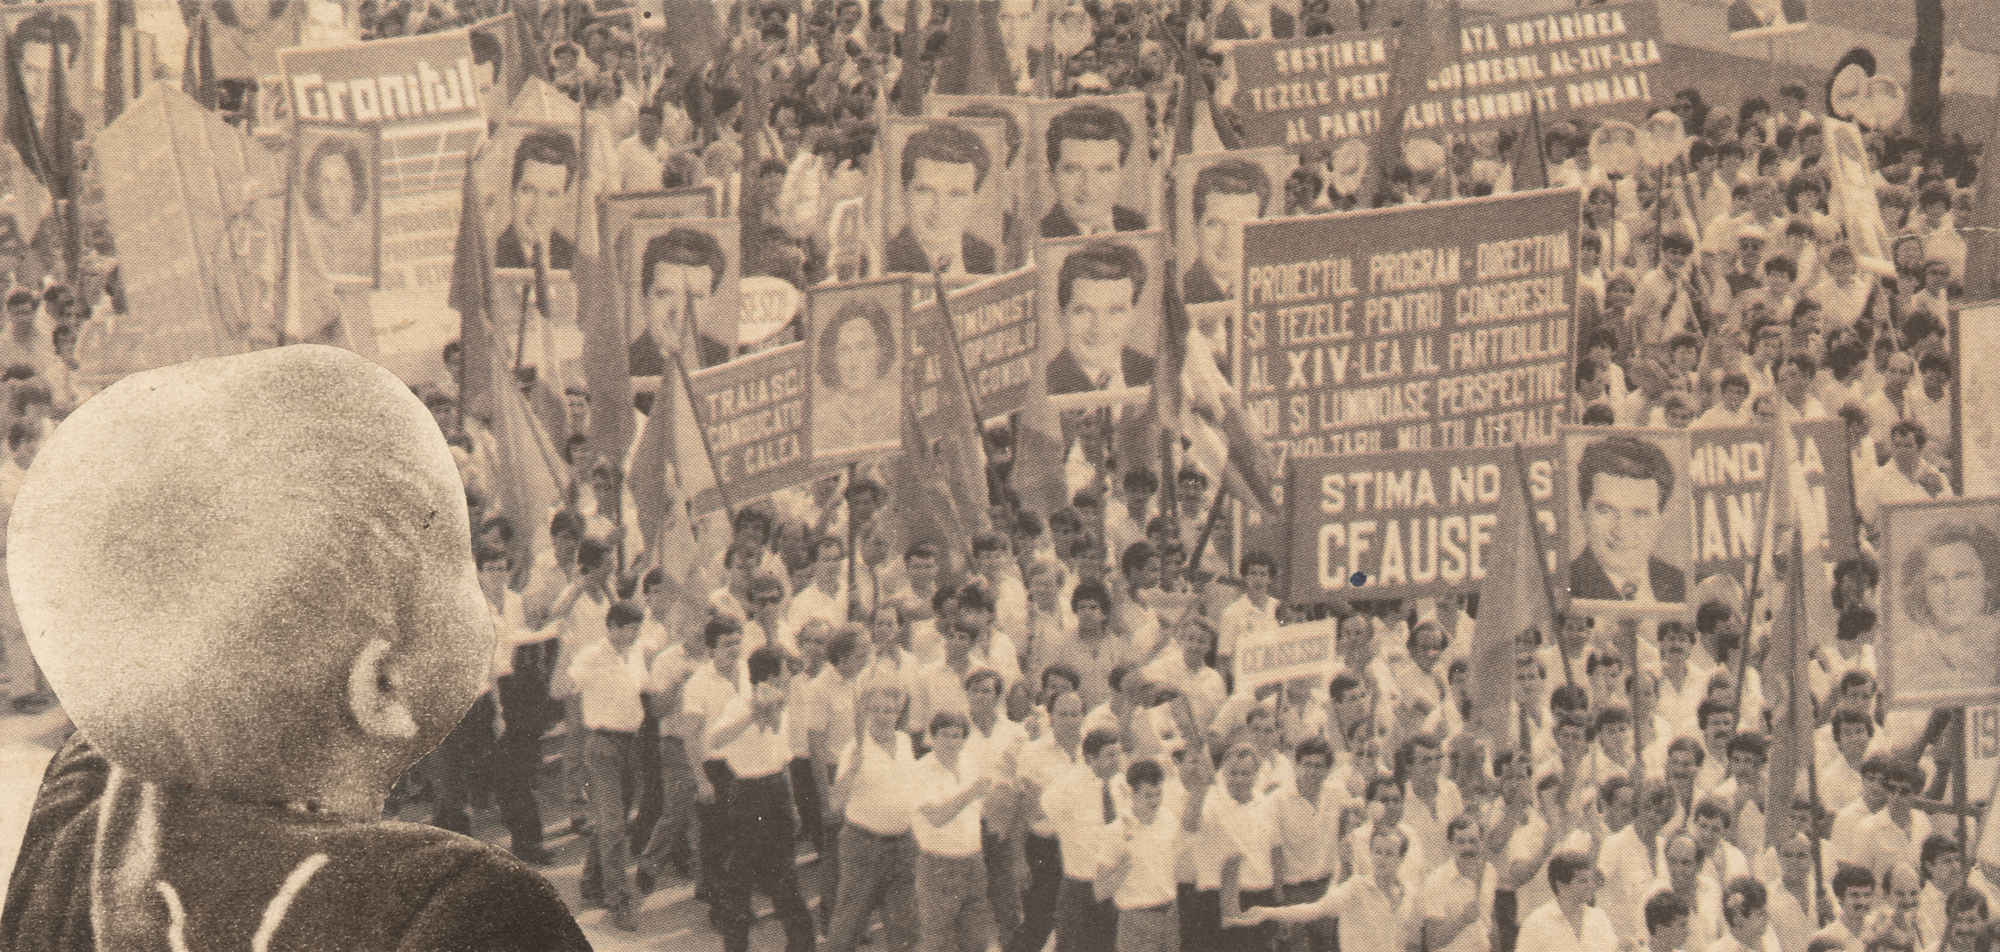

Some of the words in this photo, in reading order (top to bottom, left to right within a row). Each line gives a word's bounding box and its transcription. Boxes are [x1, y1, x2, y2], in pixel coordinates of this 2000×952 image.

[1286, 117, 1312, 144] AL
[1249, 258, 1358, 303] PROIECTUL
[1277, 300, 1354, 346] TEZELE
[1365, 290, 1442, 336] PENTRU
[1455, 275, 1569, 325] CONGRESUL
[1249, 354, 1276, 394] AL
[1413, 336, 1441, 376] AL
[1449, 317, 1568, 370] PARTIDULUI
[1319, 380, 1430, 430] LUMINOASE
[1437, 361, 1566, 417] PERSPECTIVE
[1321, 468, 1438, 514] STIMA
